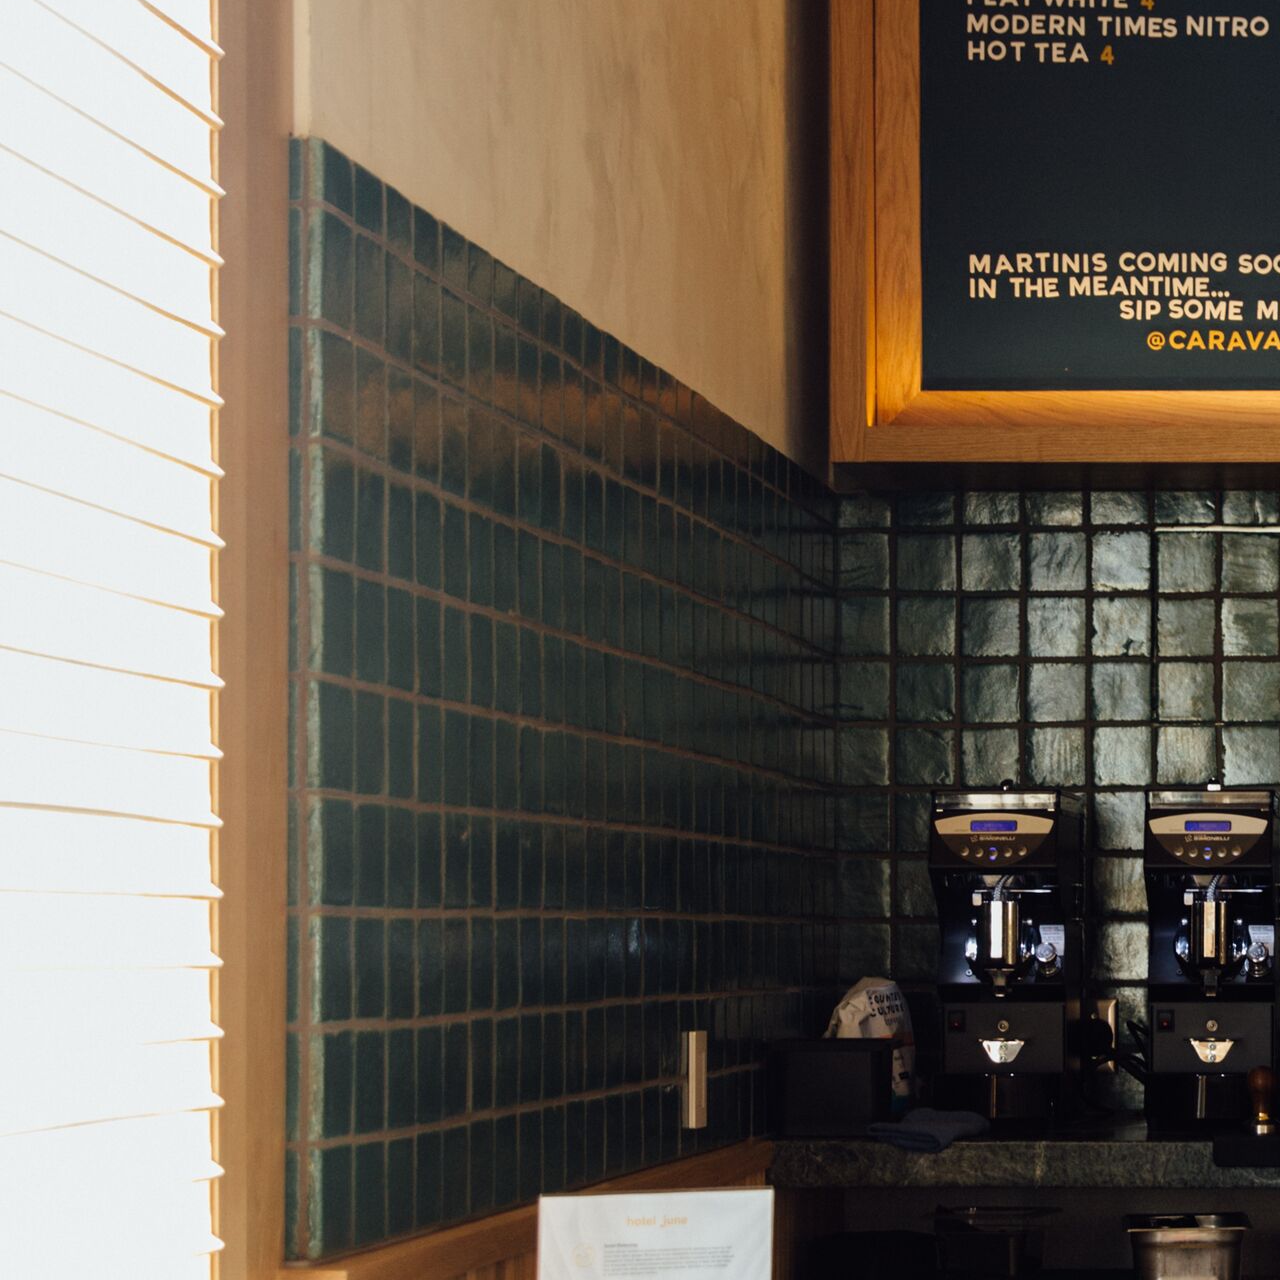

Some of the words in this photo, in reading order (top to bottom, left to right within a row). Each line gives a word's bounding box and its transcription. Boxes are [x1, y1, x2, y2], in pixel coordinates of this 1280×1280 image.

[967, 14, 1085, 36] MODERN
[1098, 16, 1177, 37] TIMES
[1187, 16, 1269, 37] NITRO
[968, 41, 1025, 61] HOT
[1035, 43, 1088, 62] TEA
[1101, 46, 1114, 64] 4
[970, 253, 1107, 274] MARTINIS
[1119, 252, 1227, 272] COMING
[970, 278, 996, 298] IN
[1009, 278, 1059, 297] THE
[1070, 276, 1230, 298] MEANTIME...
[1120, 300, 1161, 320] SIP
[1169, 299, 1243, 320] SOME
